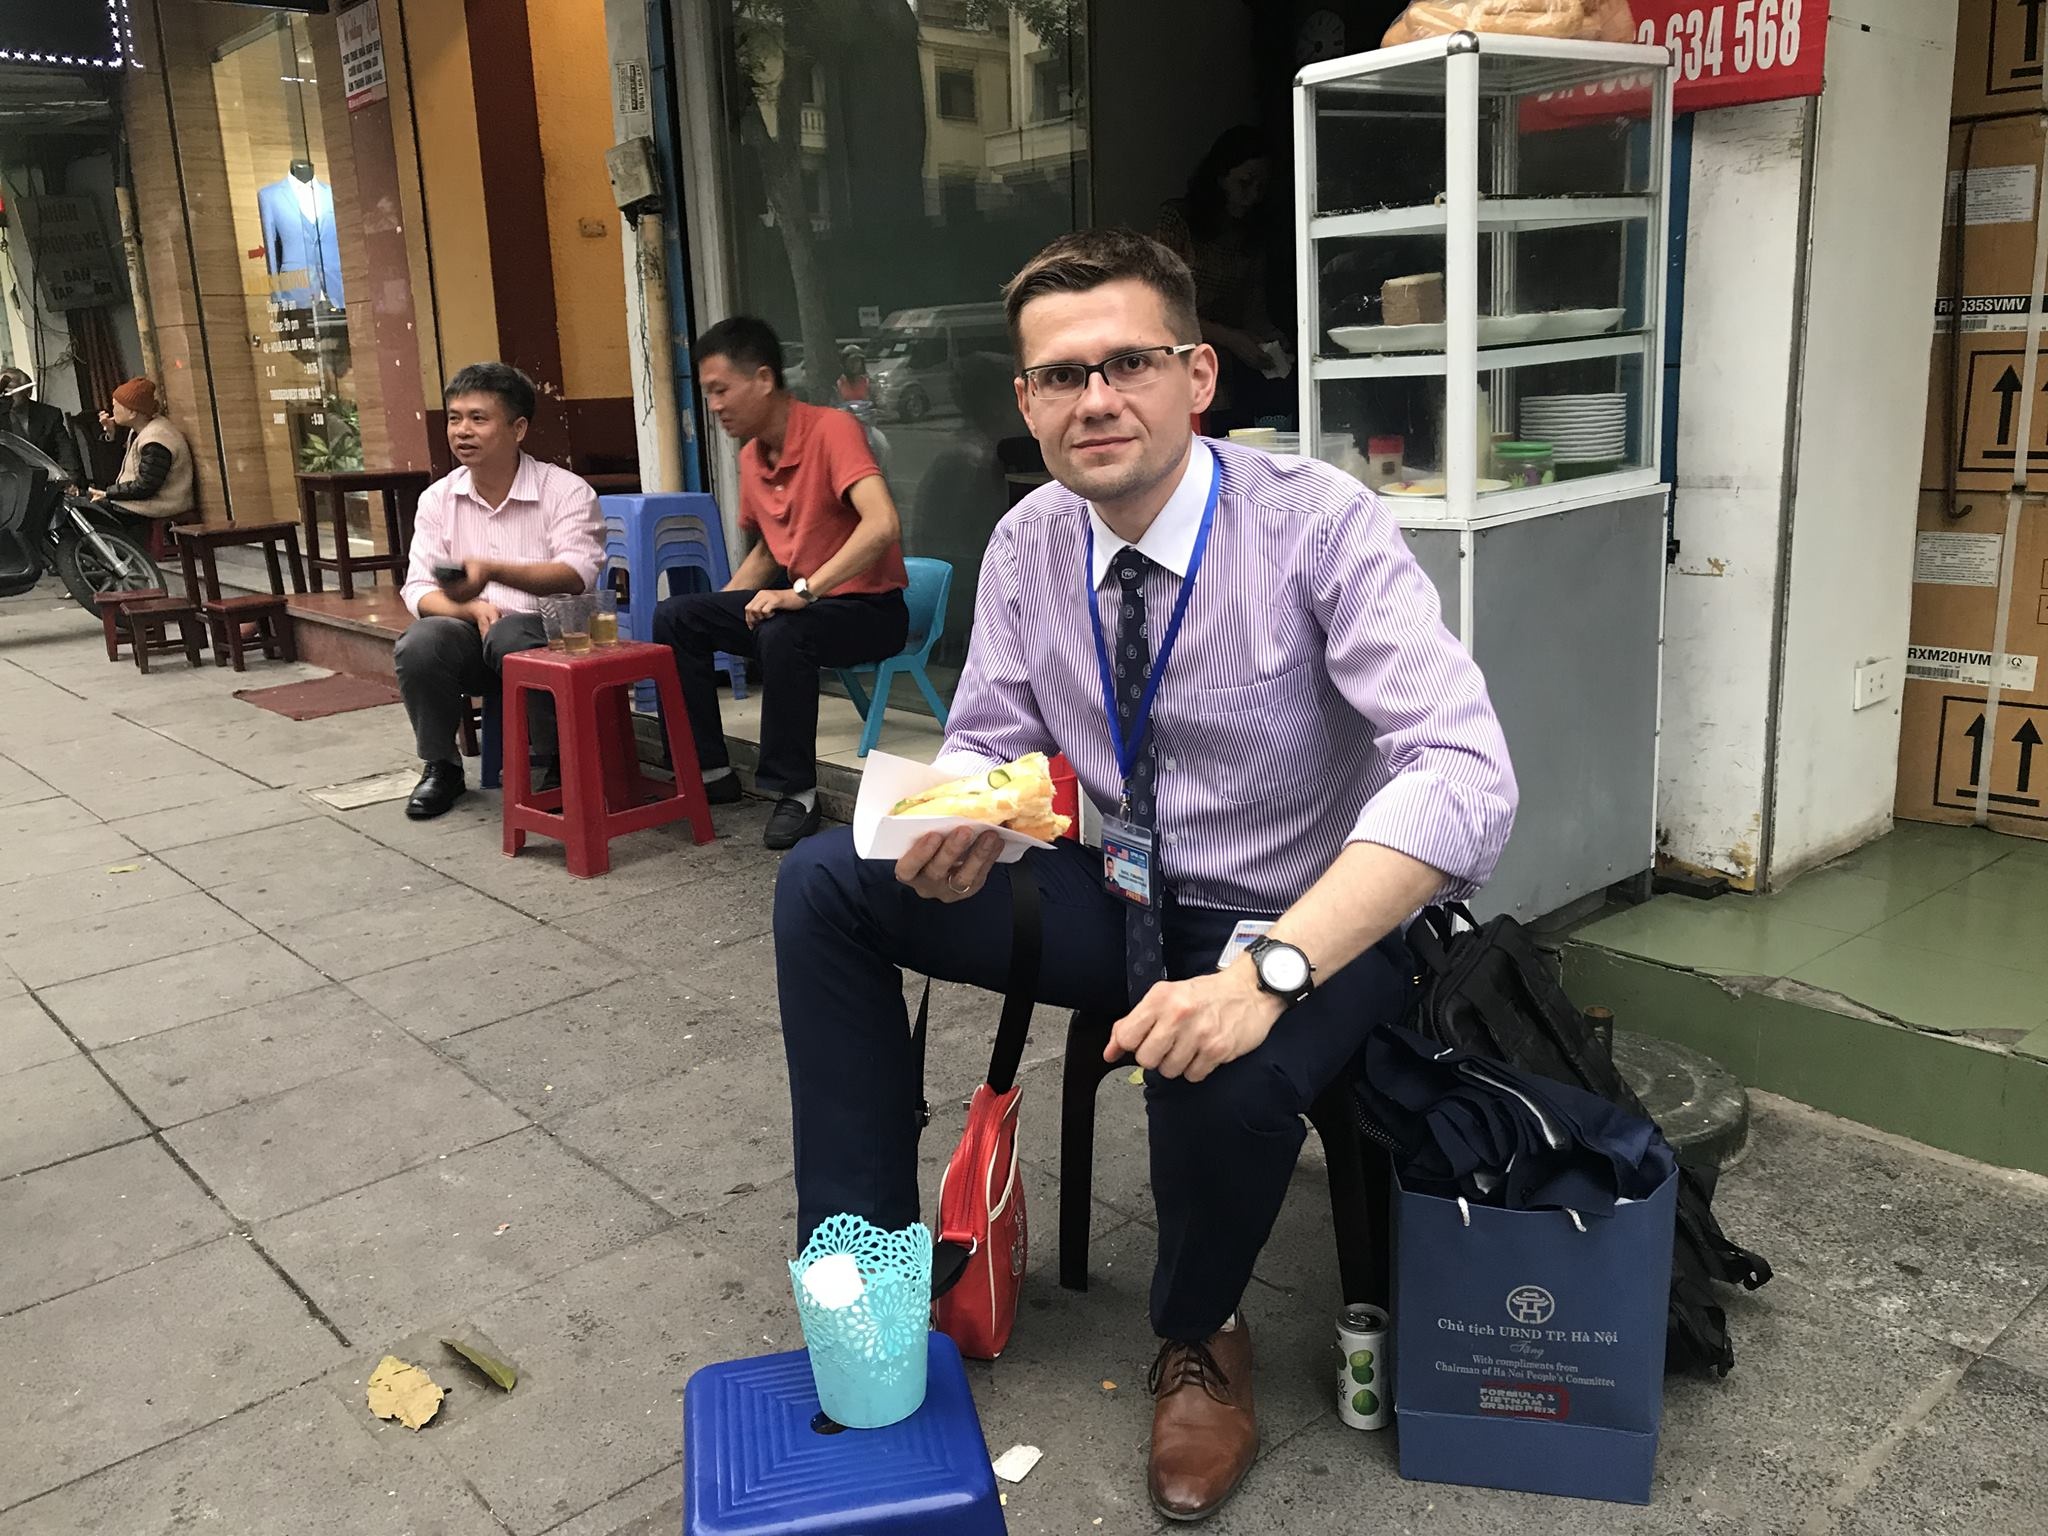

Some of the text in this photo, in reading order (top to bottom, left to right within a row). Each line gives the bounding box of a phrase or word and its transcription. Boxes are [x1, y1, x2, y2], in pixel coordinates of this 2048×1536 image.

[1665, 6, 1725, 84] 634
[1734, 0, 1803, 74] 568
[1438, 1318, 1618, 1345] Chủ tịch UBND TP. Hà Nội
[1472, 1354, 1578, 1373] With compliments from
[1435, 1360, 1480, 1375] Chairman
[1482, 1366, 1492, 1376] of
[1526, 1370, 1564, 1383] People's
[1565, 1374, 1616, 1387] Committee
[1480, 1388, 1545, 1401] FORMULA
[1480, 1394, 1542, 1406] VIETNAM
[1524, 1405, 1557, 1415] PRIX
